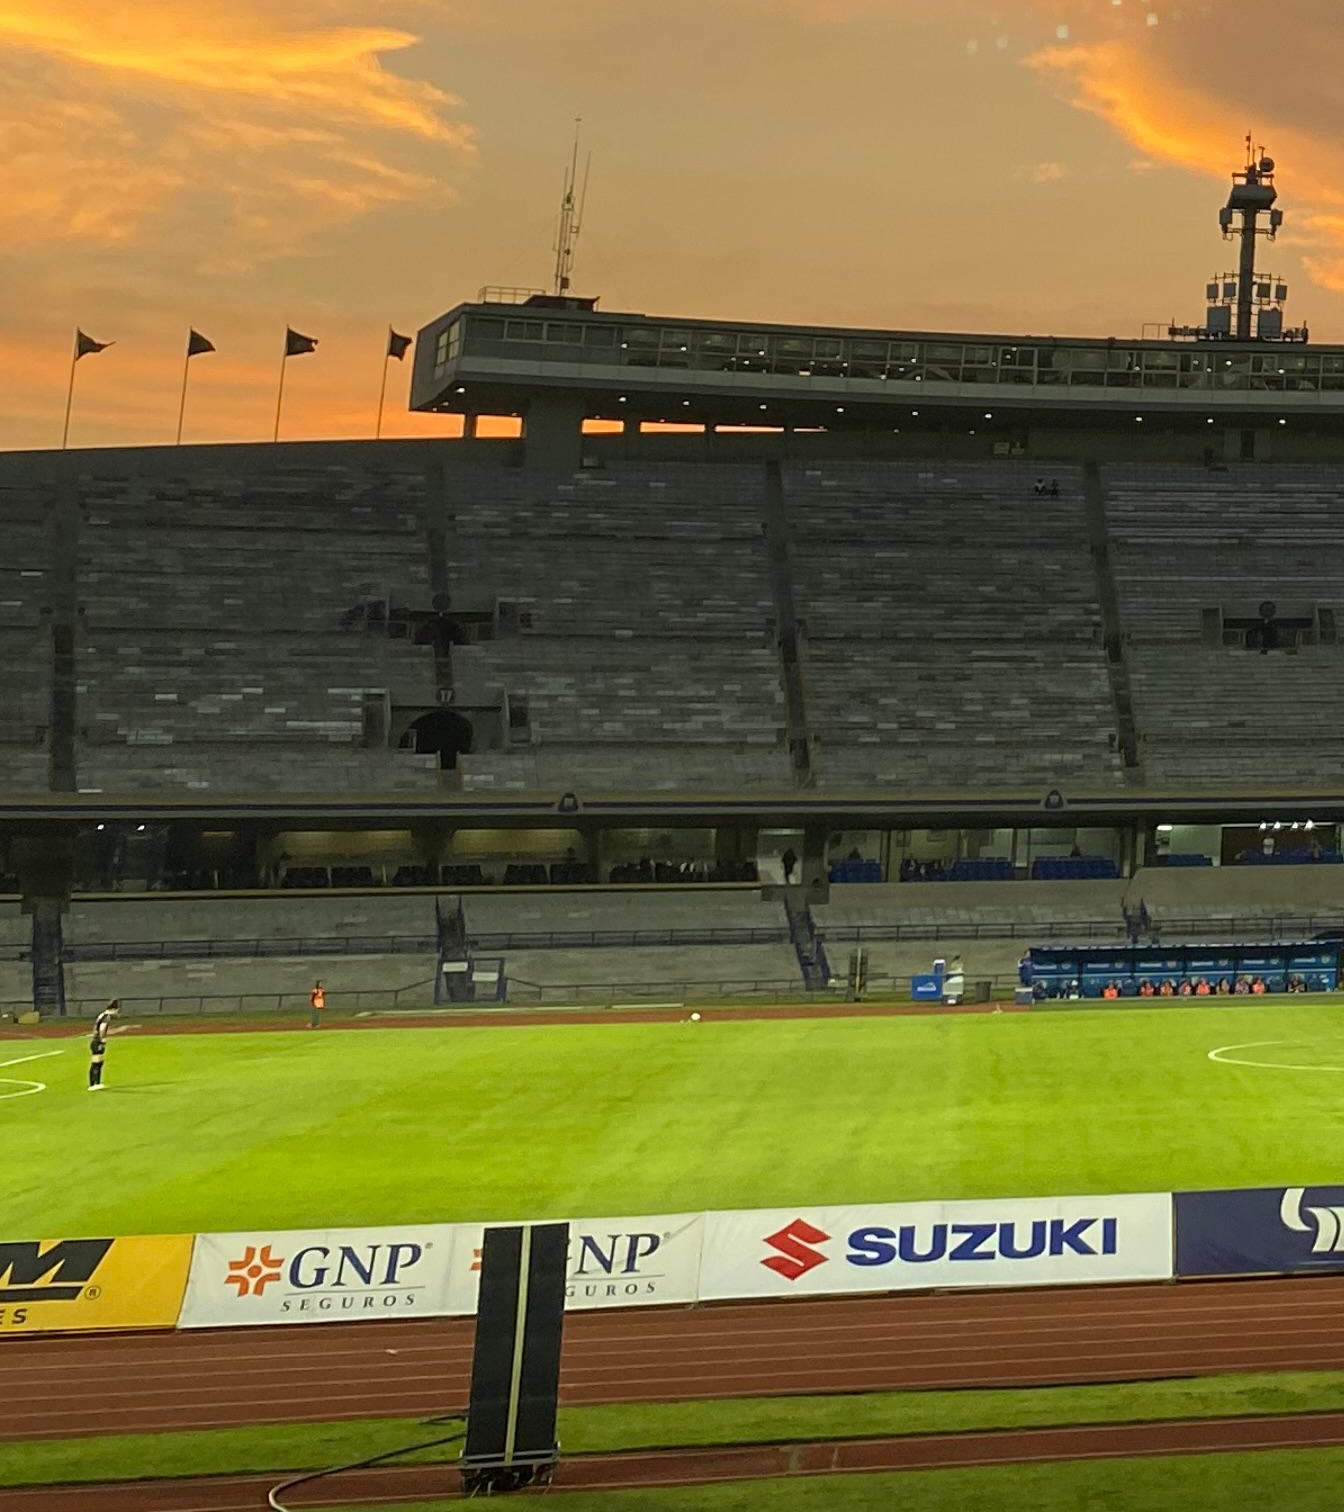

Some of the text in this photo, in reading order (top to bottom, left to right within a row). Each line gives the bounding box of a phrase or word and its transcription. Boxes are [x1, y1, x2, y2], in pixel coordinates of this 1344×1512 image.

[567, 1233, 661, 1275] NP
[845, 1217, 1118, 1268] SUZUKI
[289, 1242, 422, 1289] GNP
[280, 1293, 415, 1313] SEGUROS
[564, 1281, 656, 1297] GUROS
